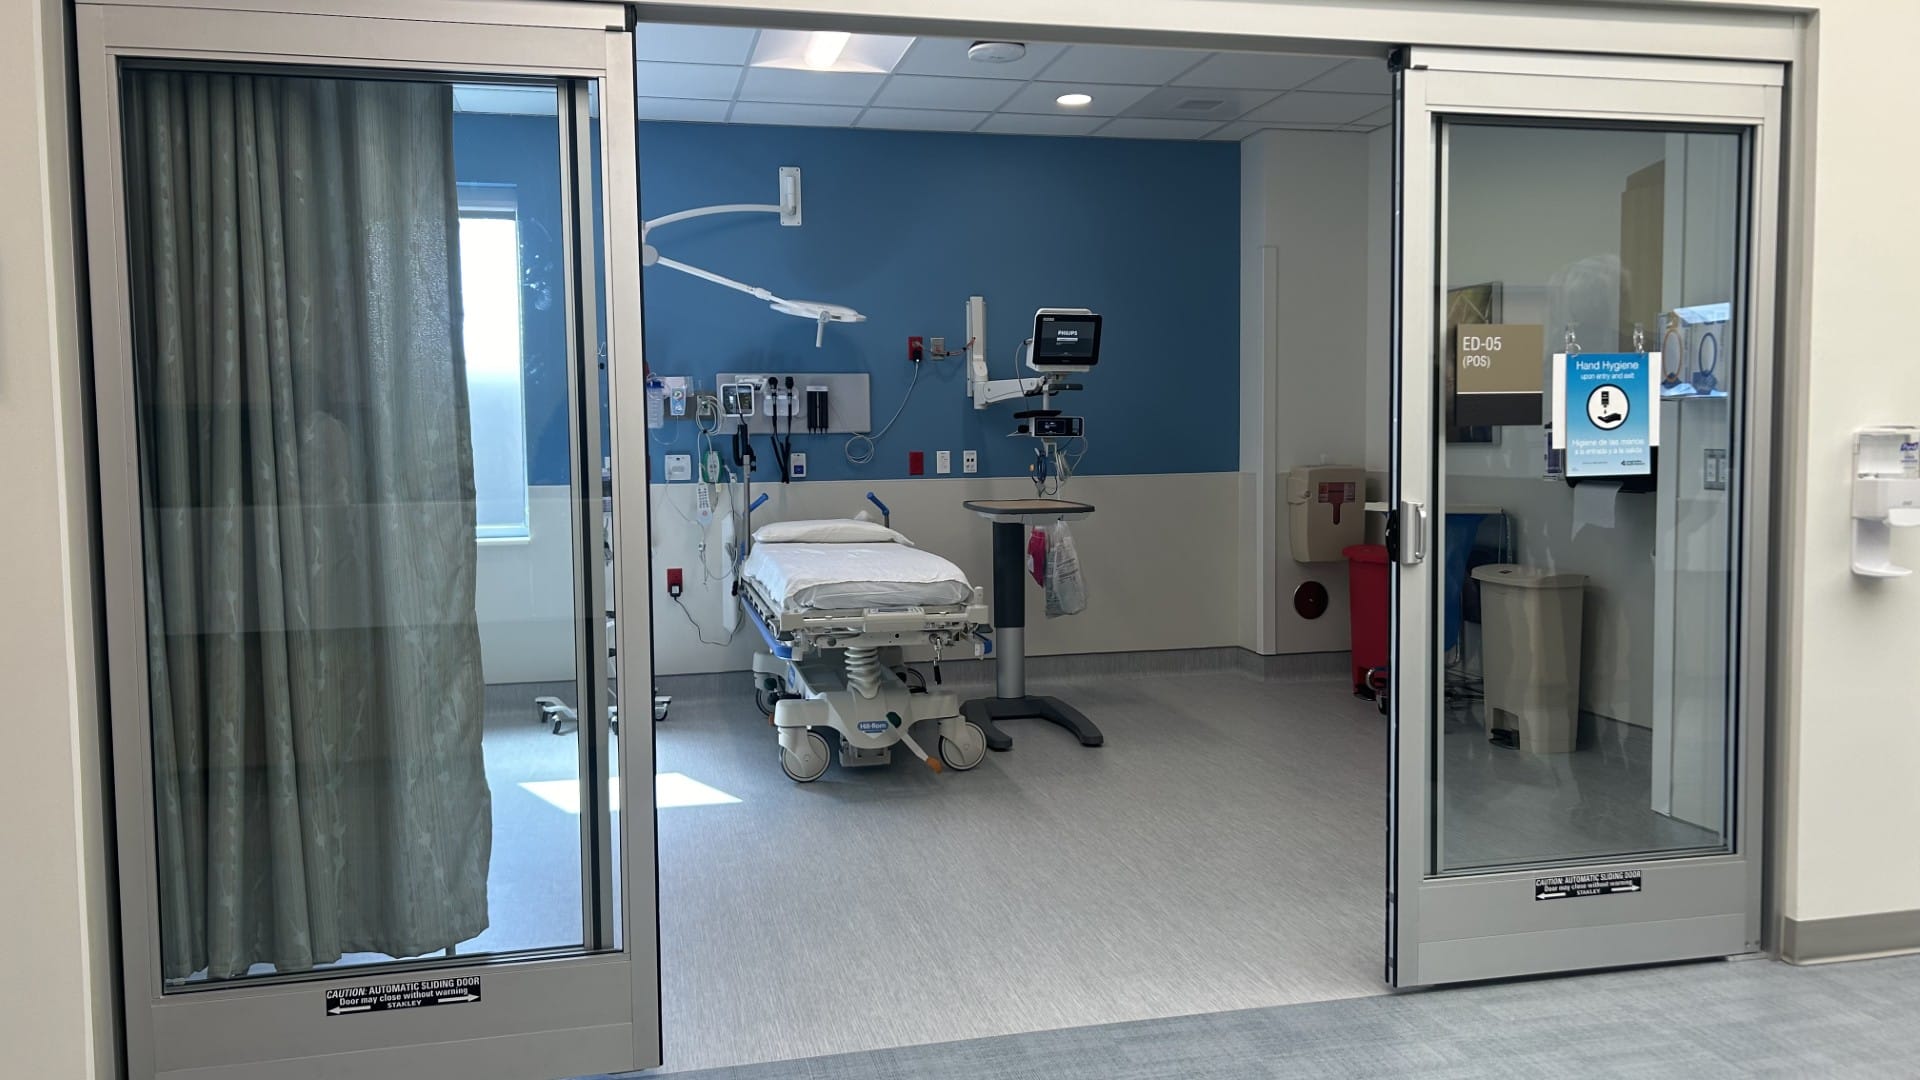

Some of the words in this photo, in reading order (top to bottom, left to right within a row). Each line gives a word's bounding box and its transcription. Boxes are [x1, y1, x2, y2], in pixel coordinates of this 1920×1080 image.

[1463, 336, 1502, 350] ED-05
[1462, 356, 1490, 368] (POS)
[1576, 361, 1600, 370] Hand
[1602, 361, 1639, 371] Hygiene
[1564, 875, 1599, 884] AUTOMATIC
[326, 989, 367, 999] CAUTION:
[369, 983, 420, 995] AUTOMATIC
[421, 980, 454, 990] SLIDING
[456, 977, 480, 986] DOOR
[340, 997, 358, 1006] Door
[360, 996, 377, 1005] may
[379, 993, 401, 1002] close
[404, 990, 434, 1000] without
[436, 987, 468, 997] warning
[387, 1000, 422, 1008] STANLEY
